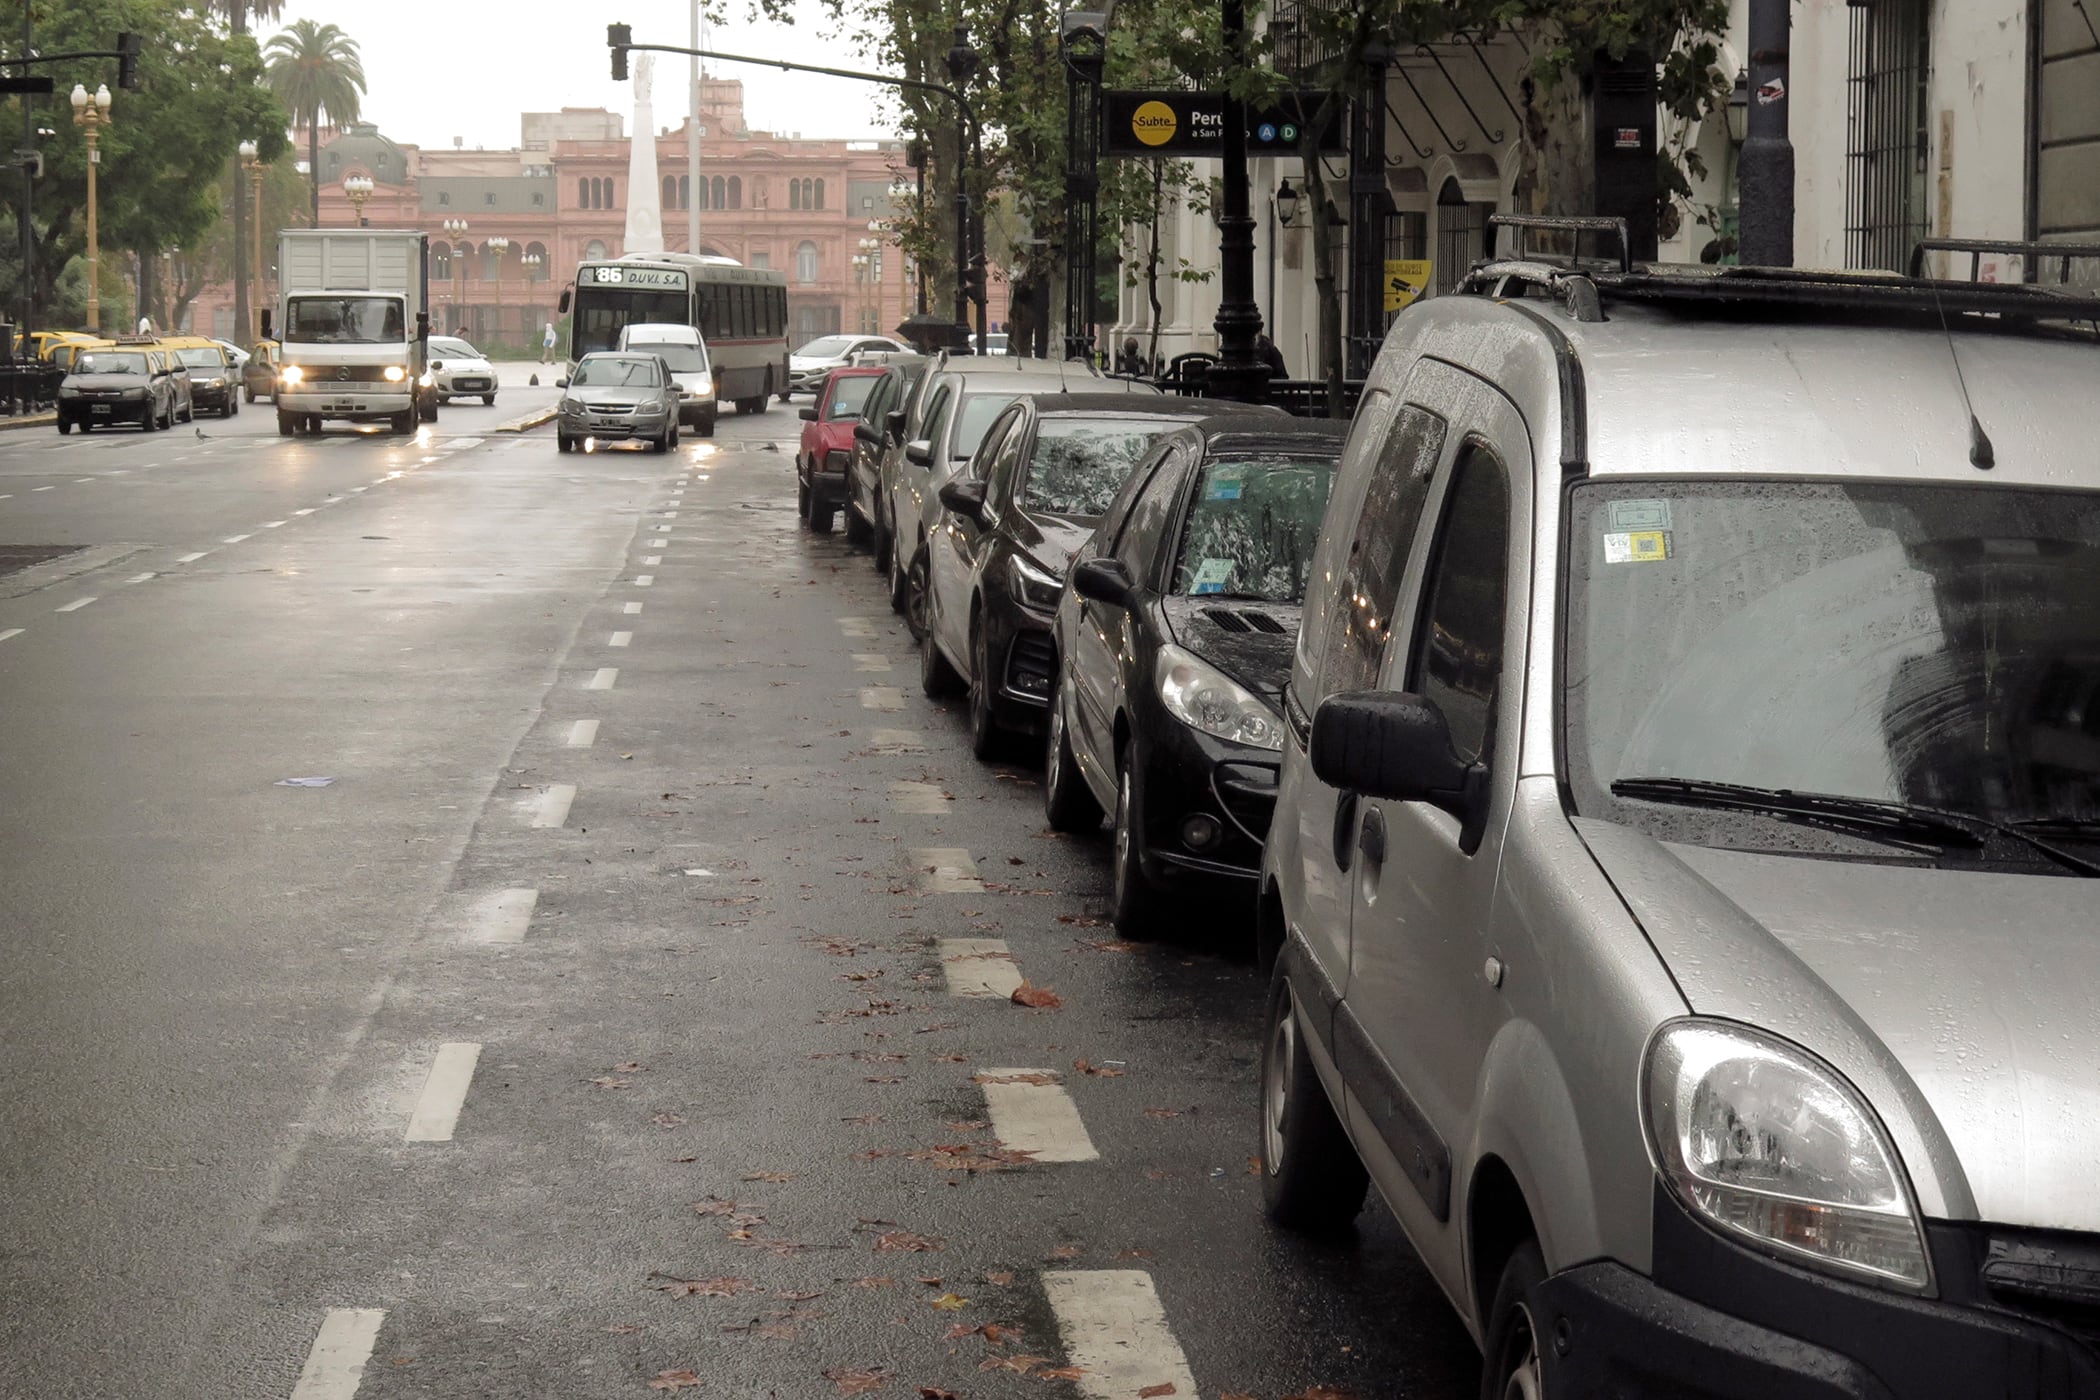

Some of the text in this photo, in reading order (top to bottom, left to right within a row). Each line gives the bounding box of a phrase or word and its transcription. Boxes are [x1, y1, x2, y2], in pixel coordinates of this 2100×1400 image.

[1138, 115, 1171, 127] Subte
[1191, 130, 1198, 138] a
[1199, 128, 1216, 138] San
[1261, 127, 1273, 138] A
[1284, 127, 1294, 138] D
[663, 274, 682, 286] S.A.
